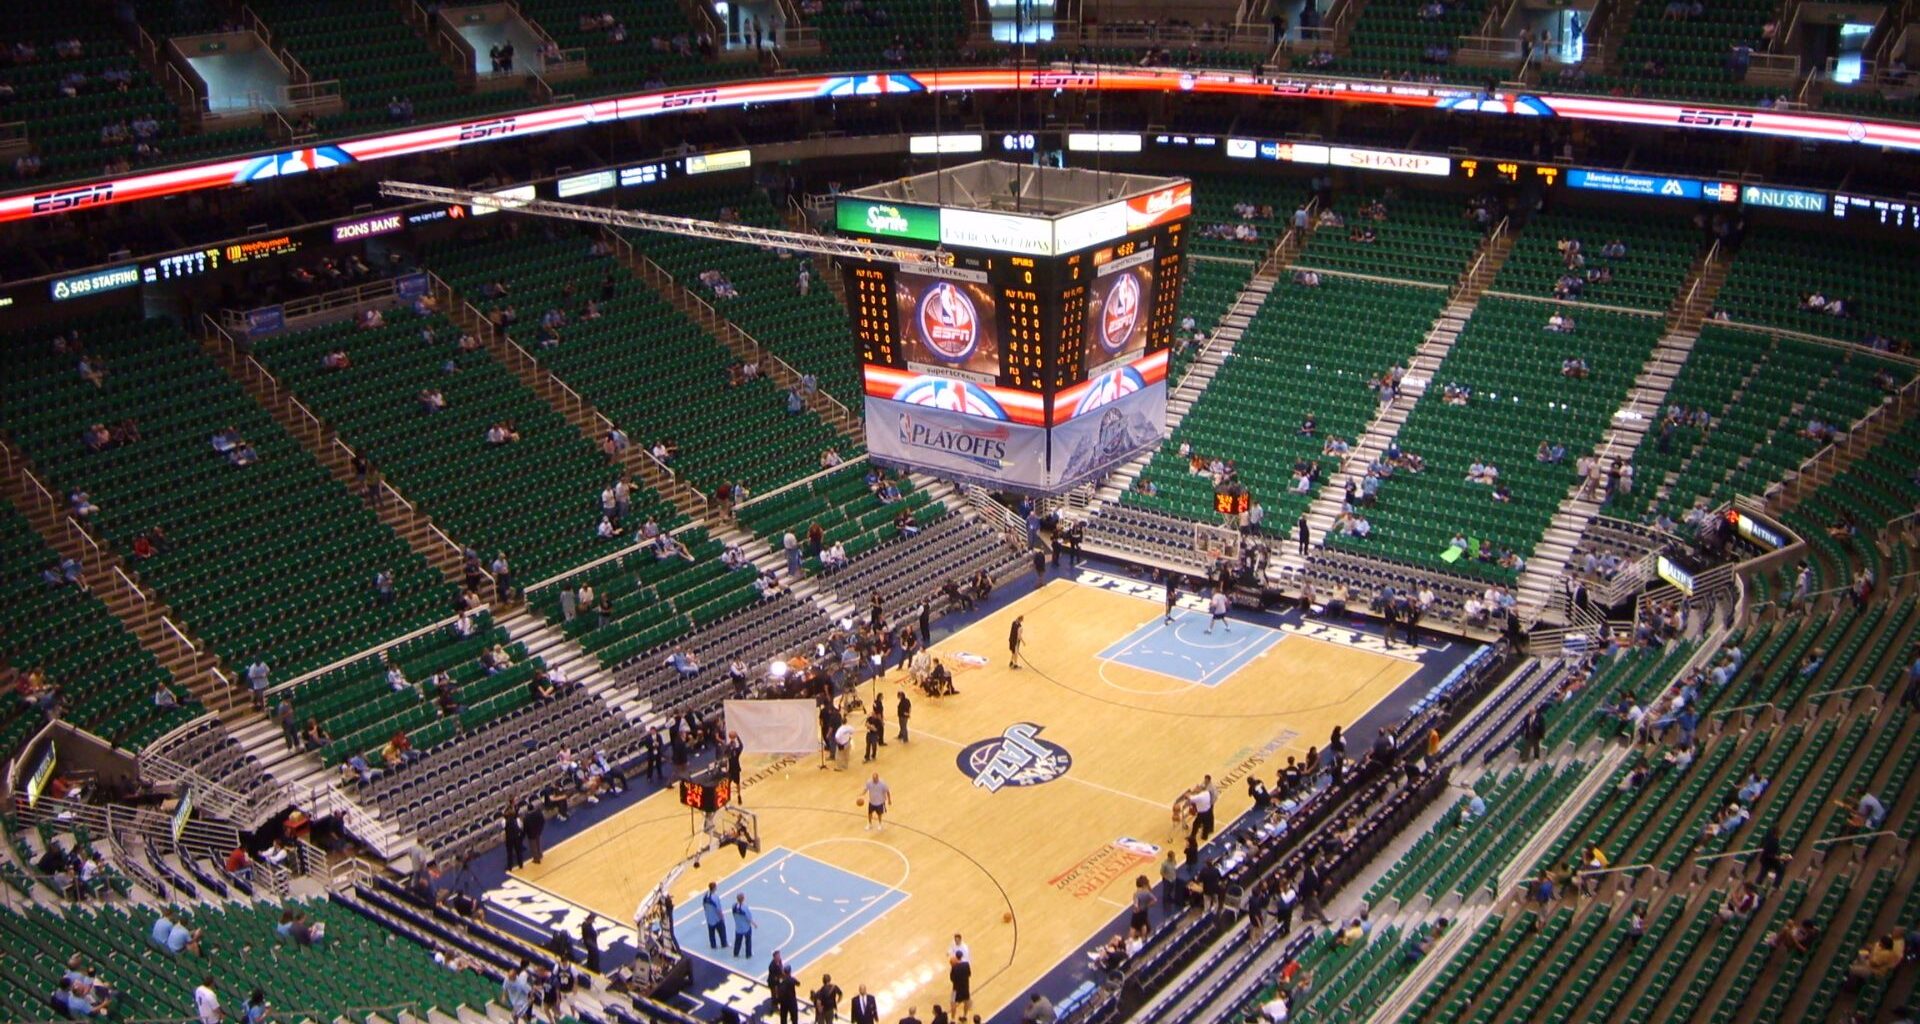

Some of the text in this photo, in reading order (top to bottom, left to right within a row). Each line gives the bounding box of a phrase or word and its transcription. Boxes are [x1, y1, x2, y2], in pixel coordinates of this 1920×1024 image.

[1030, 72, 1097, 86] ESPN
[662, 89, 718, 109] ESPN
[1677, 109, 1754, 129] ESPN
[458, 118, 516, 141] ESPN
[1350, 152, 1430, 169] SHARP
[32, 184, 114, 213] ESPN
[1761, 191, 1822, 211] NU SKIN
[336, 223, 369, 239] ZIONS
[371, 216, 400, 233] BANK
[867, 206, 908, 233] Sprite
[1012, 257, 1034, 268] SPURS
[71, 270, 138, 294] SOS STAFFING
[1025, 271, 1032, 284] 0
[1021, 303, 1026, 313] 0
[1033, 305, 1038, 314] 0
[1022, 317, 1027, 326] 0
[1034, 319, 1039, 328] 0
[932, 326, 970, 341] ESPN
[1022, 330, 1028, 340] 0
[1035, 332, 1040, 341] 0
[1023, 344, 1029, 353] 0
[1035, 346, 1041, 355] 0
[1024, 357, 1030, 366] 0
[1036, 359, 1042, 368] 0
[1016, 376, 1021, 385] 0
[912, 423, 1006, 460] PLAYOFFS
[1076, 570, 1211, 613] UTAH
[1280, 621, 1428, 661] JAZZ
[972, 722, 1053, 793] JAZZ
[1072, 851, 1138, 901] WESTERN
